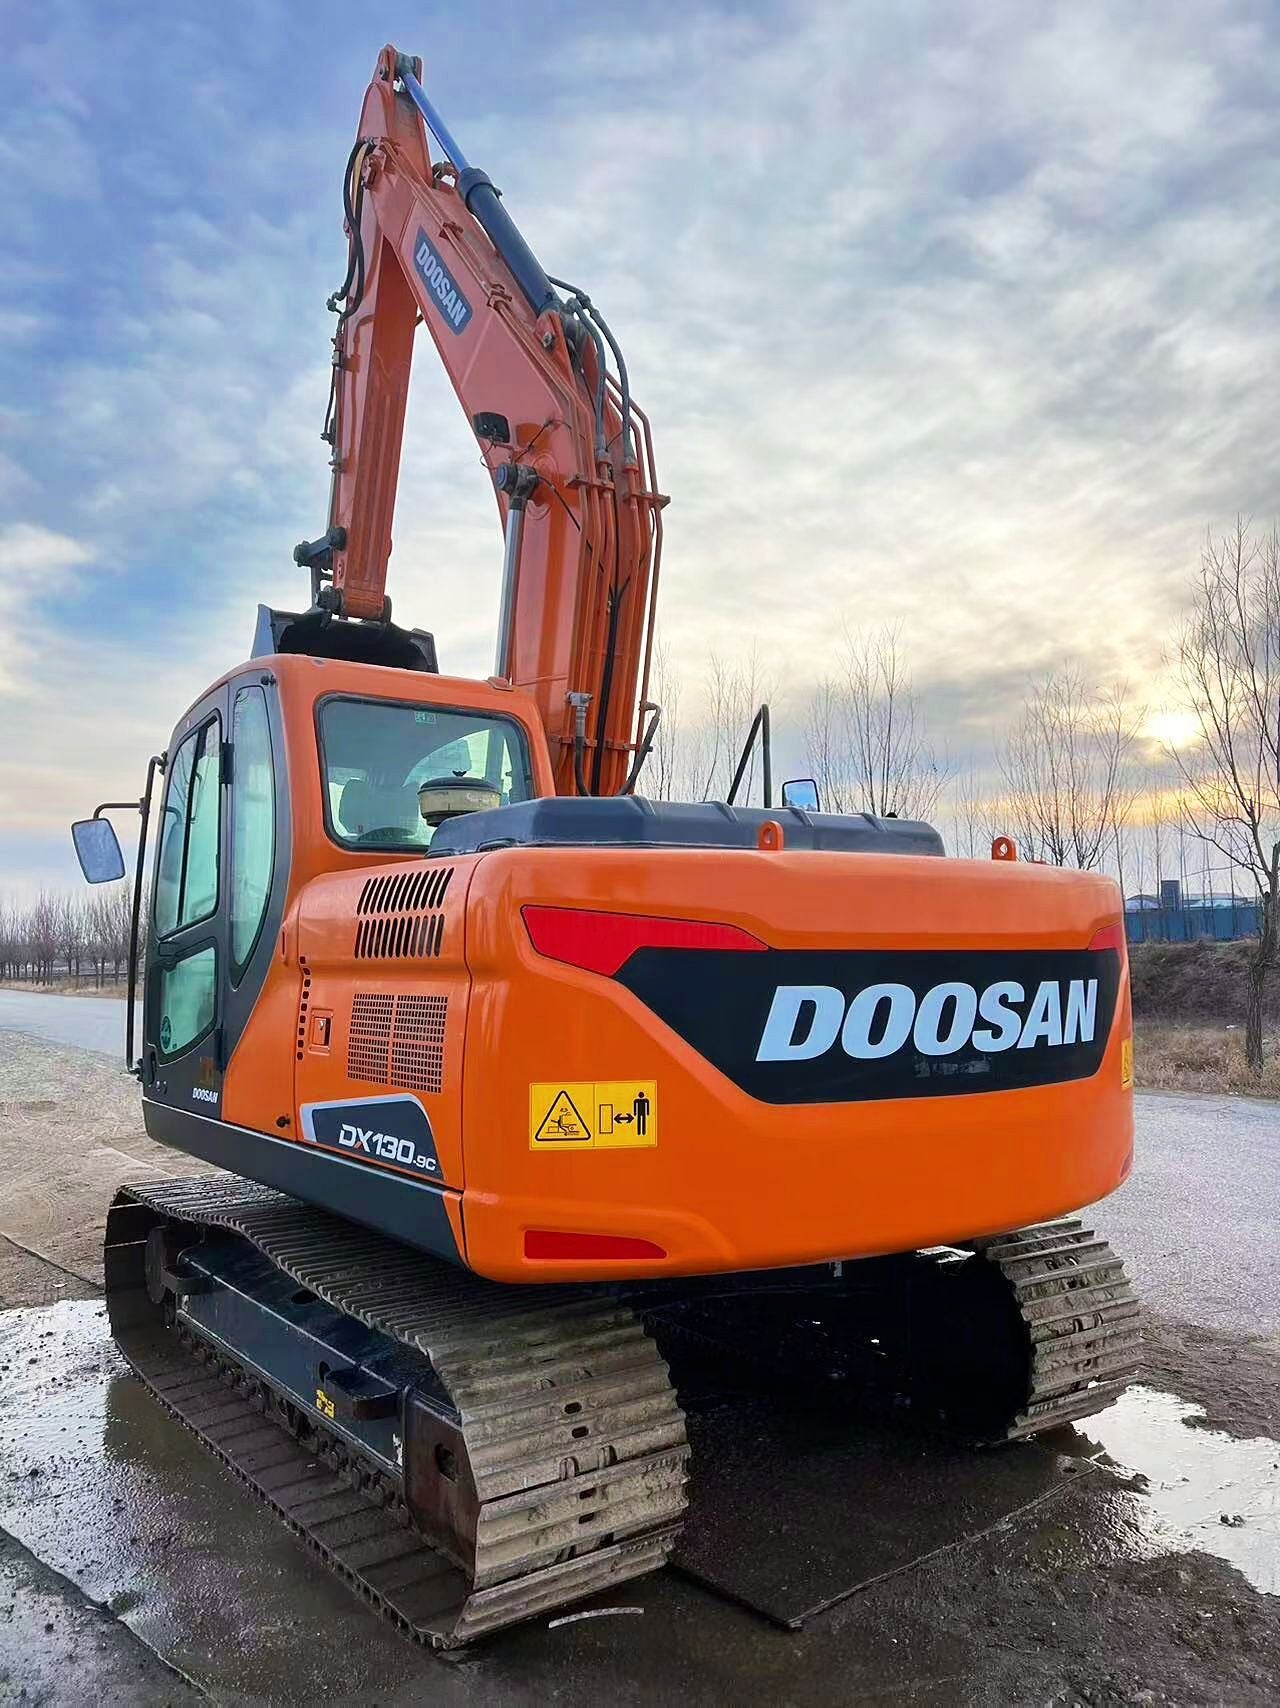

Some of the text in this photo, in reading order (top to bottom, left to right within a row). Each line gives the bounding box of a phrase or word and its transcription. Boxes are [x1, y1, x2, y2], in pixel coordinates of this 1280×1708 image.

[416, 242, 467, 326] DOOSAN
[756, 979, 1098, 1062] DOOSAN
[193, 1087, 219, 1104] DOOSAN
